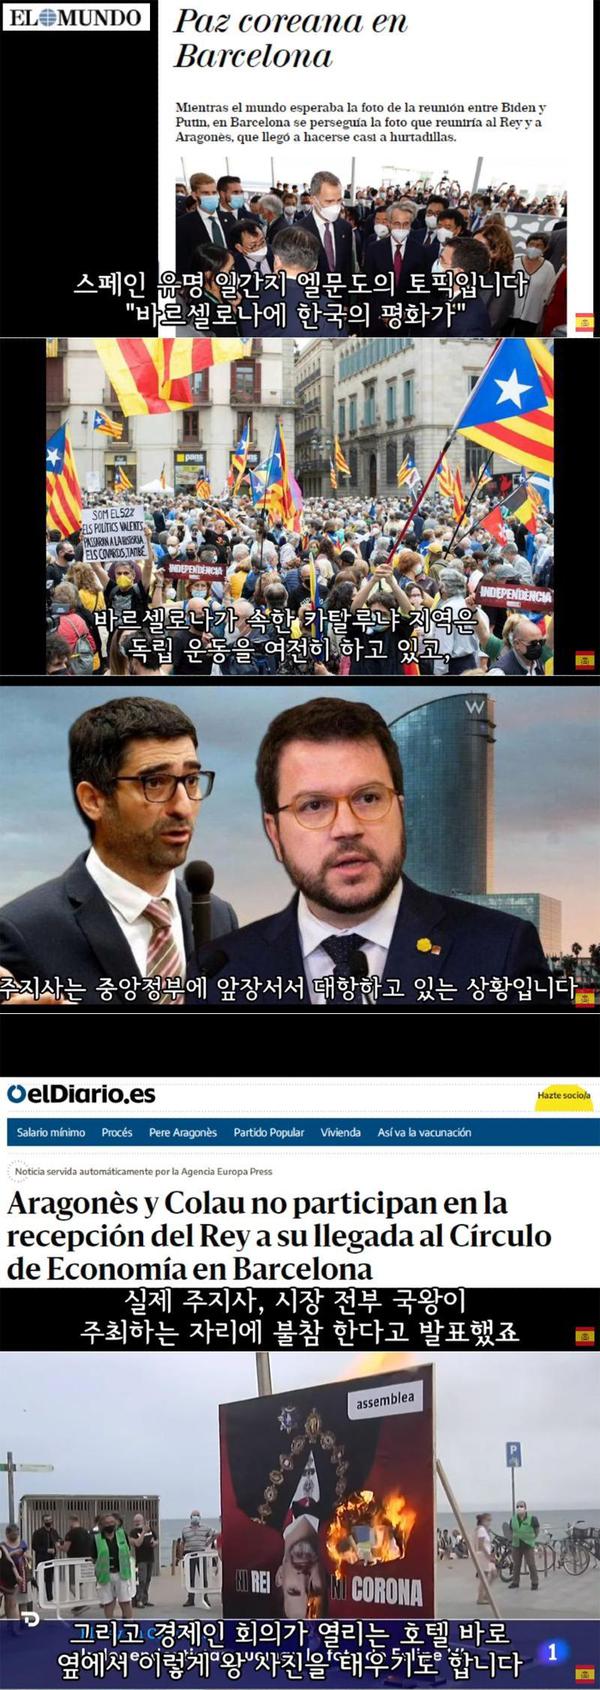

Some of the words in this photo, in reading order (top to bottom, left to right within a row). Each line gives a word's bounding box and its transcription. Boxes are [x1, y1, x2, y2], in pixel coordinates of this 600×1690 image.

[9, 9, 38, 26] EL
[57, 9, 141, 26] MUNDO
[172, 8, 232, 34] Paz
[238, 13, 364, 34] coreana
[371, 13, 409, 34] en
[174, 44, 333, 67] Barcelona
[175, 101, 229, 113] Mientras
[231, 101, 243, 113] el
[245, 101, 287, 113] mundo
[289, 101, 344, 116] esperaba
[346, 101, 358, 113] la
[361, 101, 385, 113] foto
[386, 101, 402, 113] de
[404, 101, 416, 113] la
[418, 103, 465, 113] reunión
[467, 104, 499, 113] entre
[500, 101, 537, 113] Biden
[538, 104, 547, 116] y
[465, 700, 485, 714] W
[28, 1083, 155, 1107] elDiario.es
[538, 1092, 562, 1100] Hazte
[16, 1127, 49, 1138] Salario
[50, 1127, 86, 1138] mínimo
[101, 1127, 133, 1138] Procés
[149, 1127, 171, 1138] Pere
[172, 1127, 218, 1140] Aragonès
[233, 1127, 268, 1138] Partido
[269, 1127, 305, 1140] Popular
[320, 1127, 362, 1138] Vivienda
[377, 1127, 394, 1138] Así
[394, 1129, 406, 1138] va
[408, 1127, 417, 1138] la
[418, 1127, 472, 1138] vacunación
[6, 1190, 139, 1220] Aragonès
[143, 1196, 160, 1220] y
[164, 1189, 247, 1215] Colau
[250, 1196, 288, 1215] no
[292, 1190, 438, 1220] participan
[443, 1196, 478, 1215] en
[483, 1189, 509, 1215] la
[6, 1255, 42, 1281] de
[46, 1256, 188, 1281] Economía
[192, 1262, 228, 1281] en
[232, 1255, 374, 1281] Barcelona
[356, 1391, 415, 1410] assemblea
[510, 1445, 517, 1454] P
[251, 1570, 270, 1594] REI
[352, 1576, 423, 1607] CORONA
